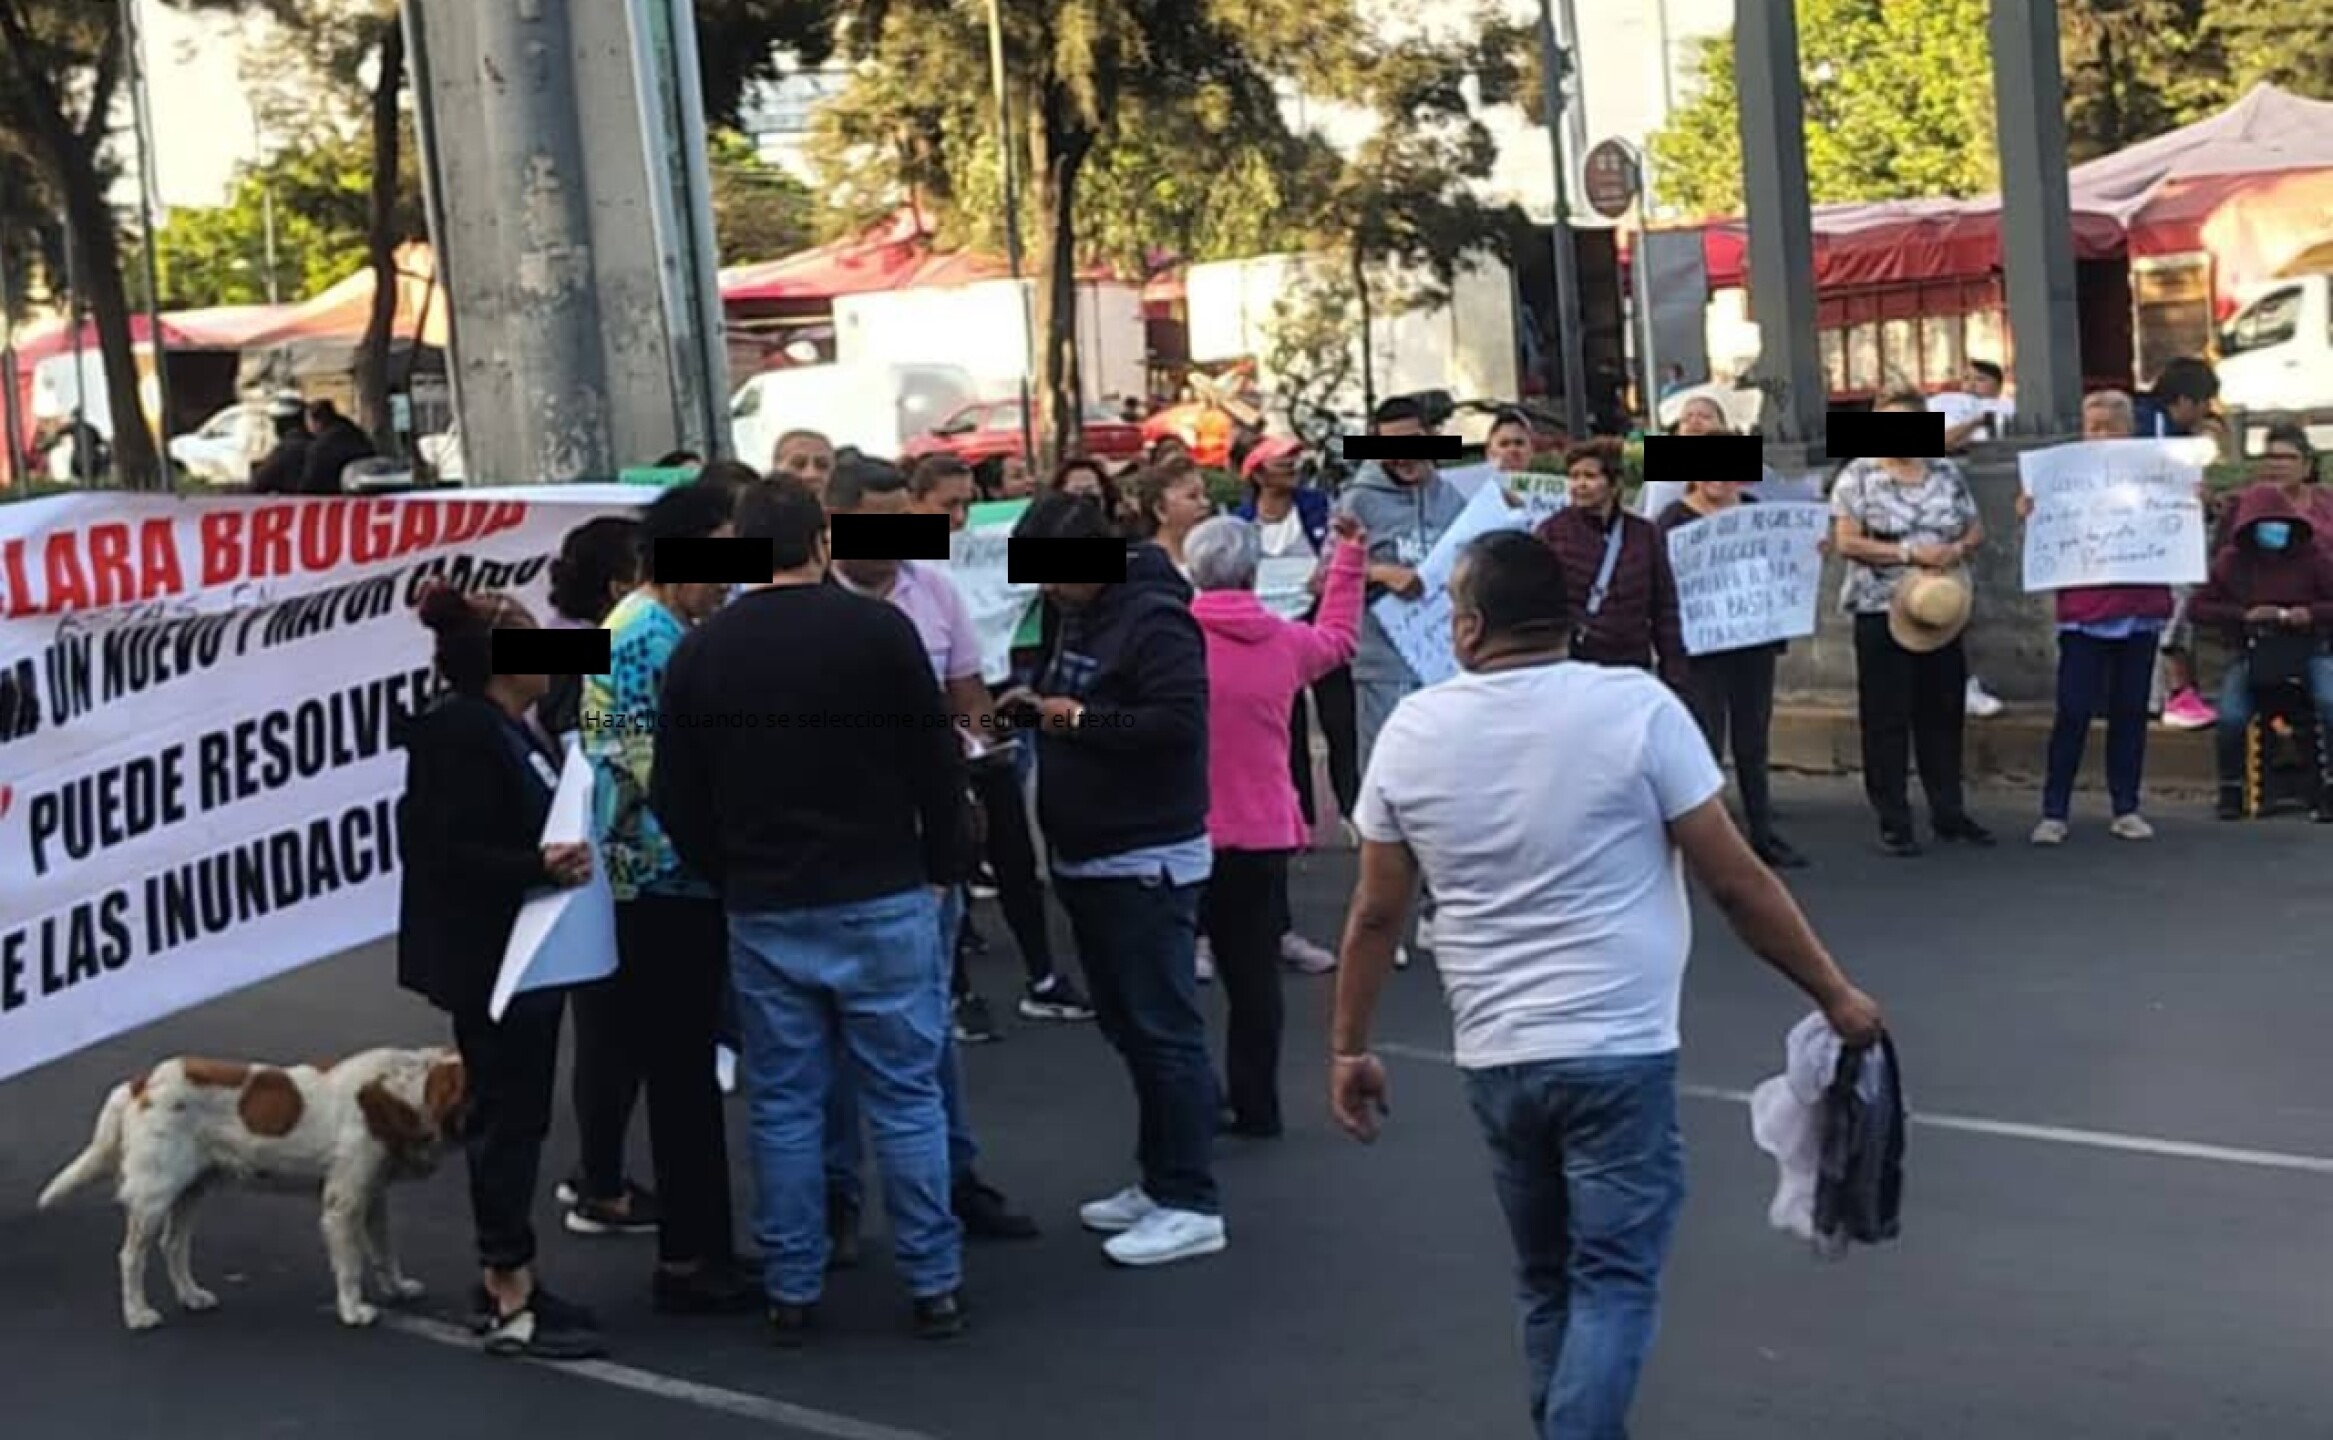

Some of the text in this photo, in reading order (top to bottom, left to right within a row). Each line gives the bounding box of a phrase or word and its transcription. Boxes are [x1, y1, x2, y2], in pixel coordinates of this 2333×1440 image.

[0, 498, 528, 619] LARA BRUGADA
[45, 632, 93, 727] UN
[103, 612, 237, 703] NUEVO
[30, 744, 187, 875] PUEDE
[41, 890, 132, 995] LAS
[145, 795, 408, 956] INUNDACI
